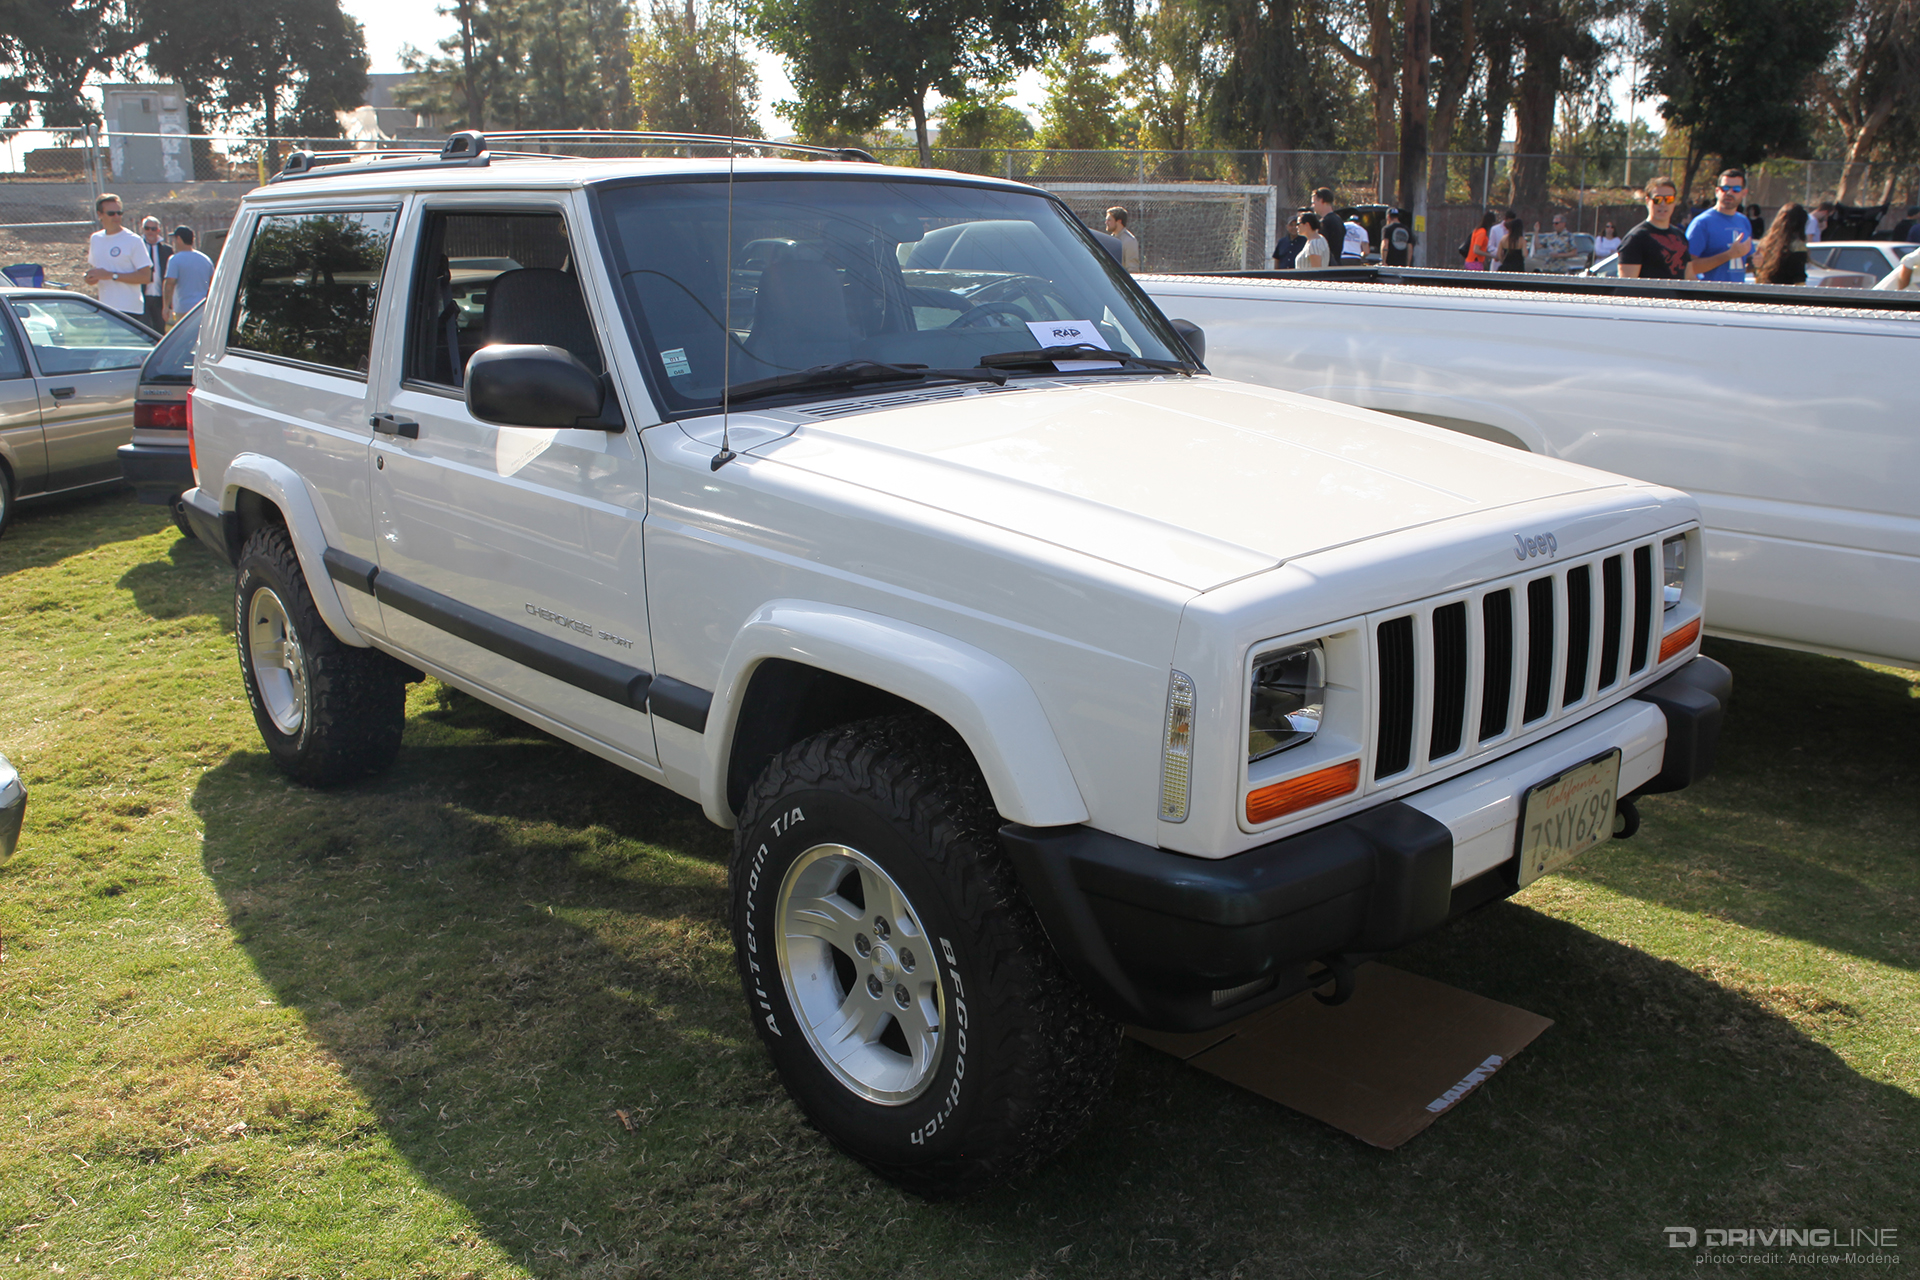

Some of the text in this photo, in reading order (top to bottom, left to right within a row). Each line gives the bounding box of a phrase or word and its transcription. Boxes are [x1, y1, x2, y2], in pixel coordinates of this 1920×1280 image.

[1052, 328, 1081, 338] RAD
[1513, 531, 1558, 561] Jeep
[525, 602, 634, 649] CHEROKEE SPORT
[1546, 774, 1602, 810] California
[1531, 788, 1611, 868] 7SXY699
[747, 807, 806, 1037] All-Terrain T/A
[910, 936, 968, 1146] BFGoodrich
